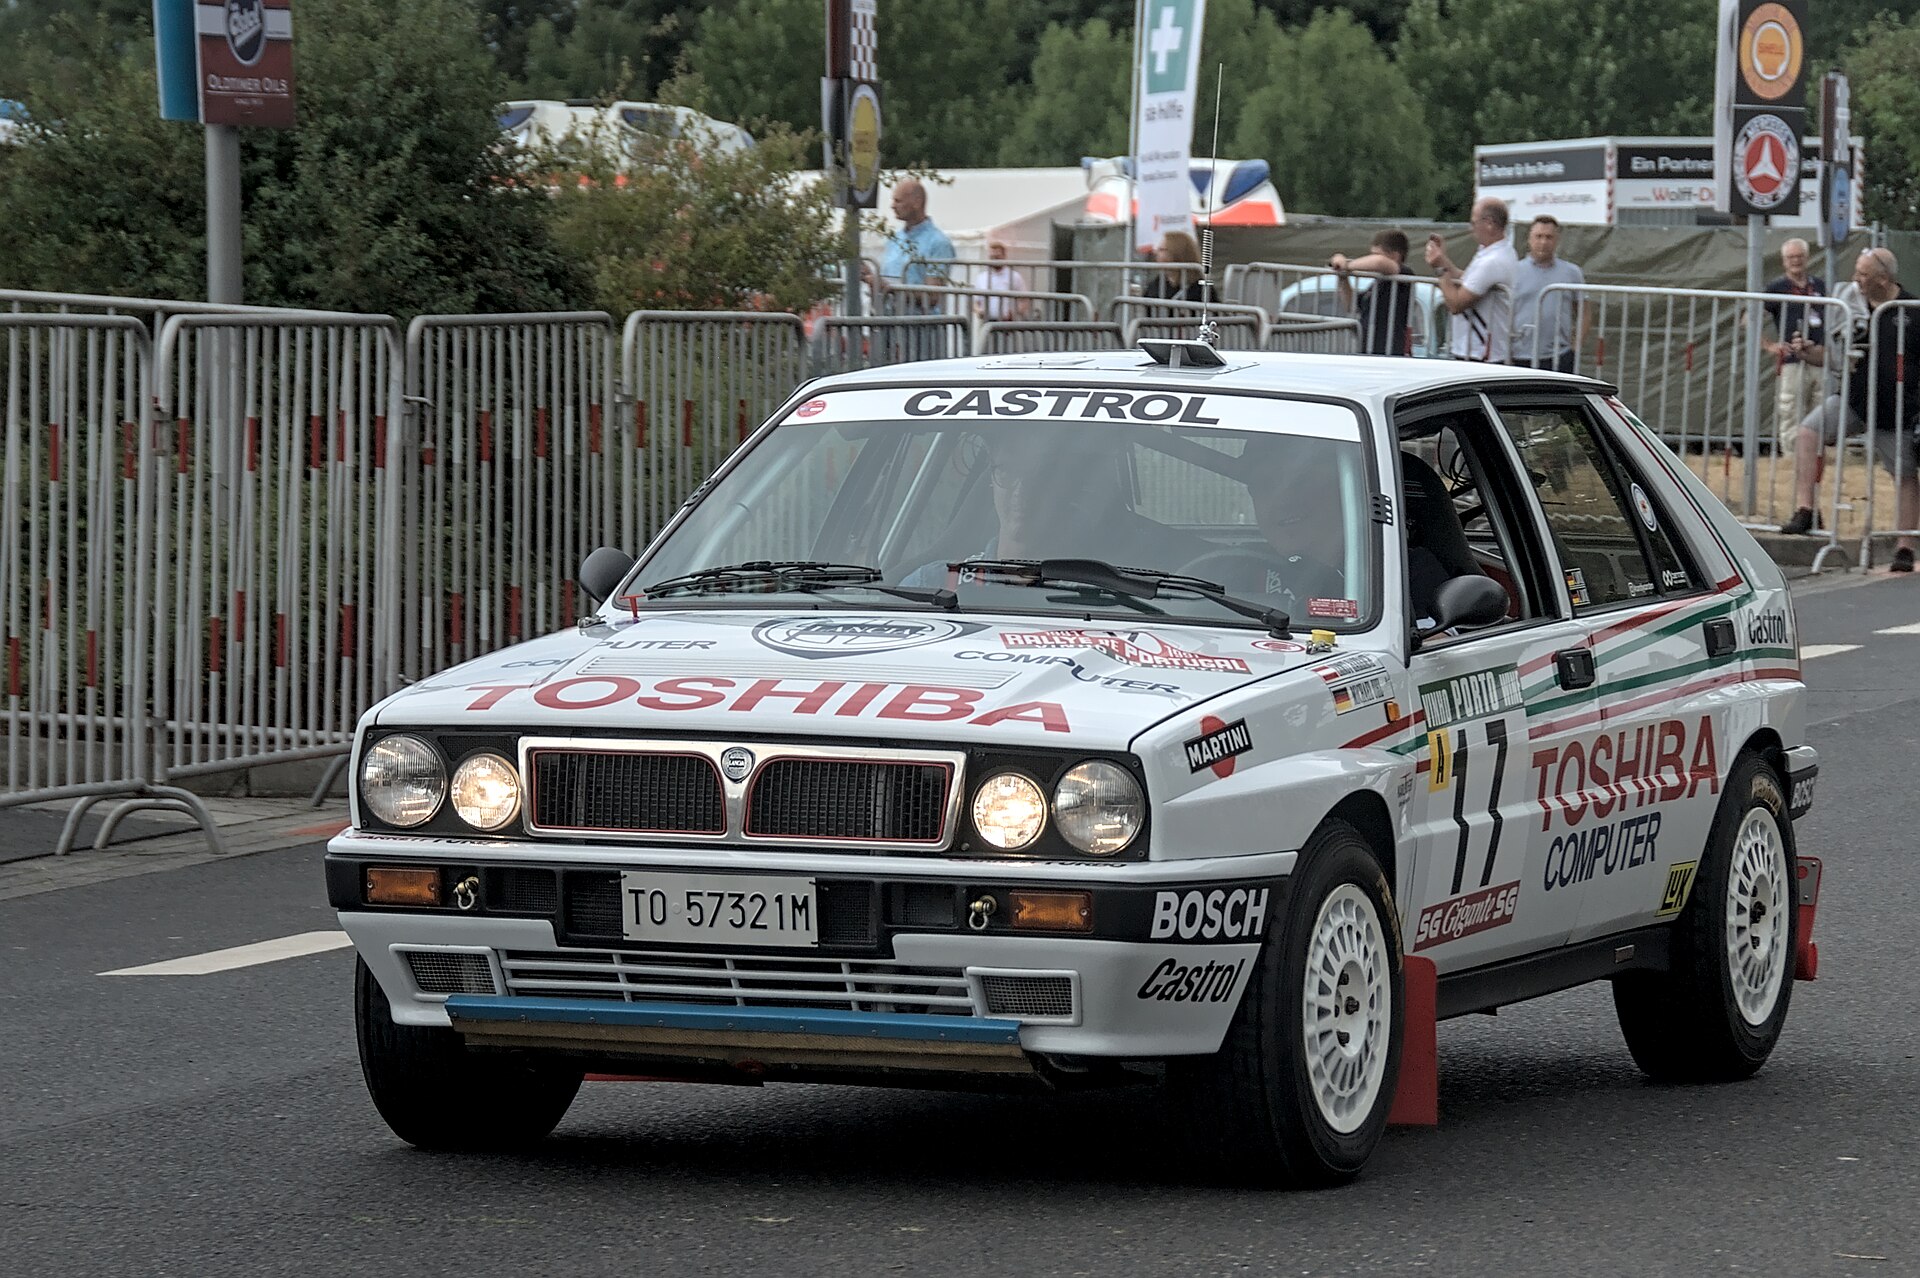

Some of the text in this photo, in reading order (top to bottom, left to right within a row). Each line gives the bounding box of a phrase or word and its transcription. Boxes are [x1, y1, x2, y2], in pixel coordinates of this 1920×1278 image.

[904, 389, 1220, 425] CASTROL
[810, 624, 912, 636] LANCIA
[1748, 608, 1788, 644] Castrol
[953, 650, 1181, 694] COMPUTER
[1006, 633, 1093, 646] RALLYE
[1098, 638, 1119, 653] DE
[1125, 643, 1247, 671] PORTUGAL
[463, 675, 1071, 734] TOSHIBA
[1421, 670, 1523, 728] VINHO PORTO WINE
[1188, 725, 1249, 768] MARTINI
[1532, 715, 1719, 832] TOSHIBA
[1451, 718, 1508, 896] 17
[1544, 811, 1661, 892] COMPUTER
[628, 888, 810, 931] TO 57321M
[1150, 888, 1269, 939] BOSCH
[1416, 886, 1518, 944] SG Gigante SG
[1137, 958, 1246, 1003] Castrol
